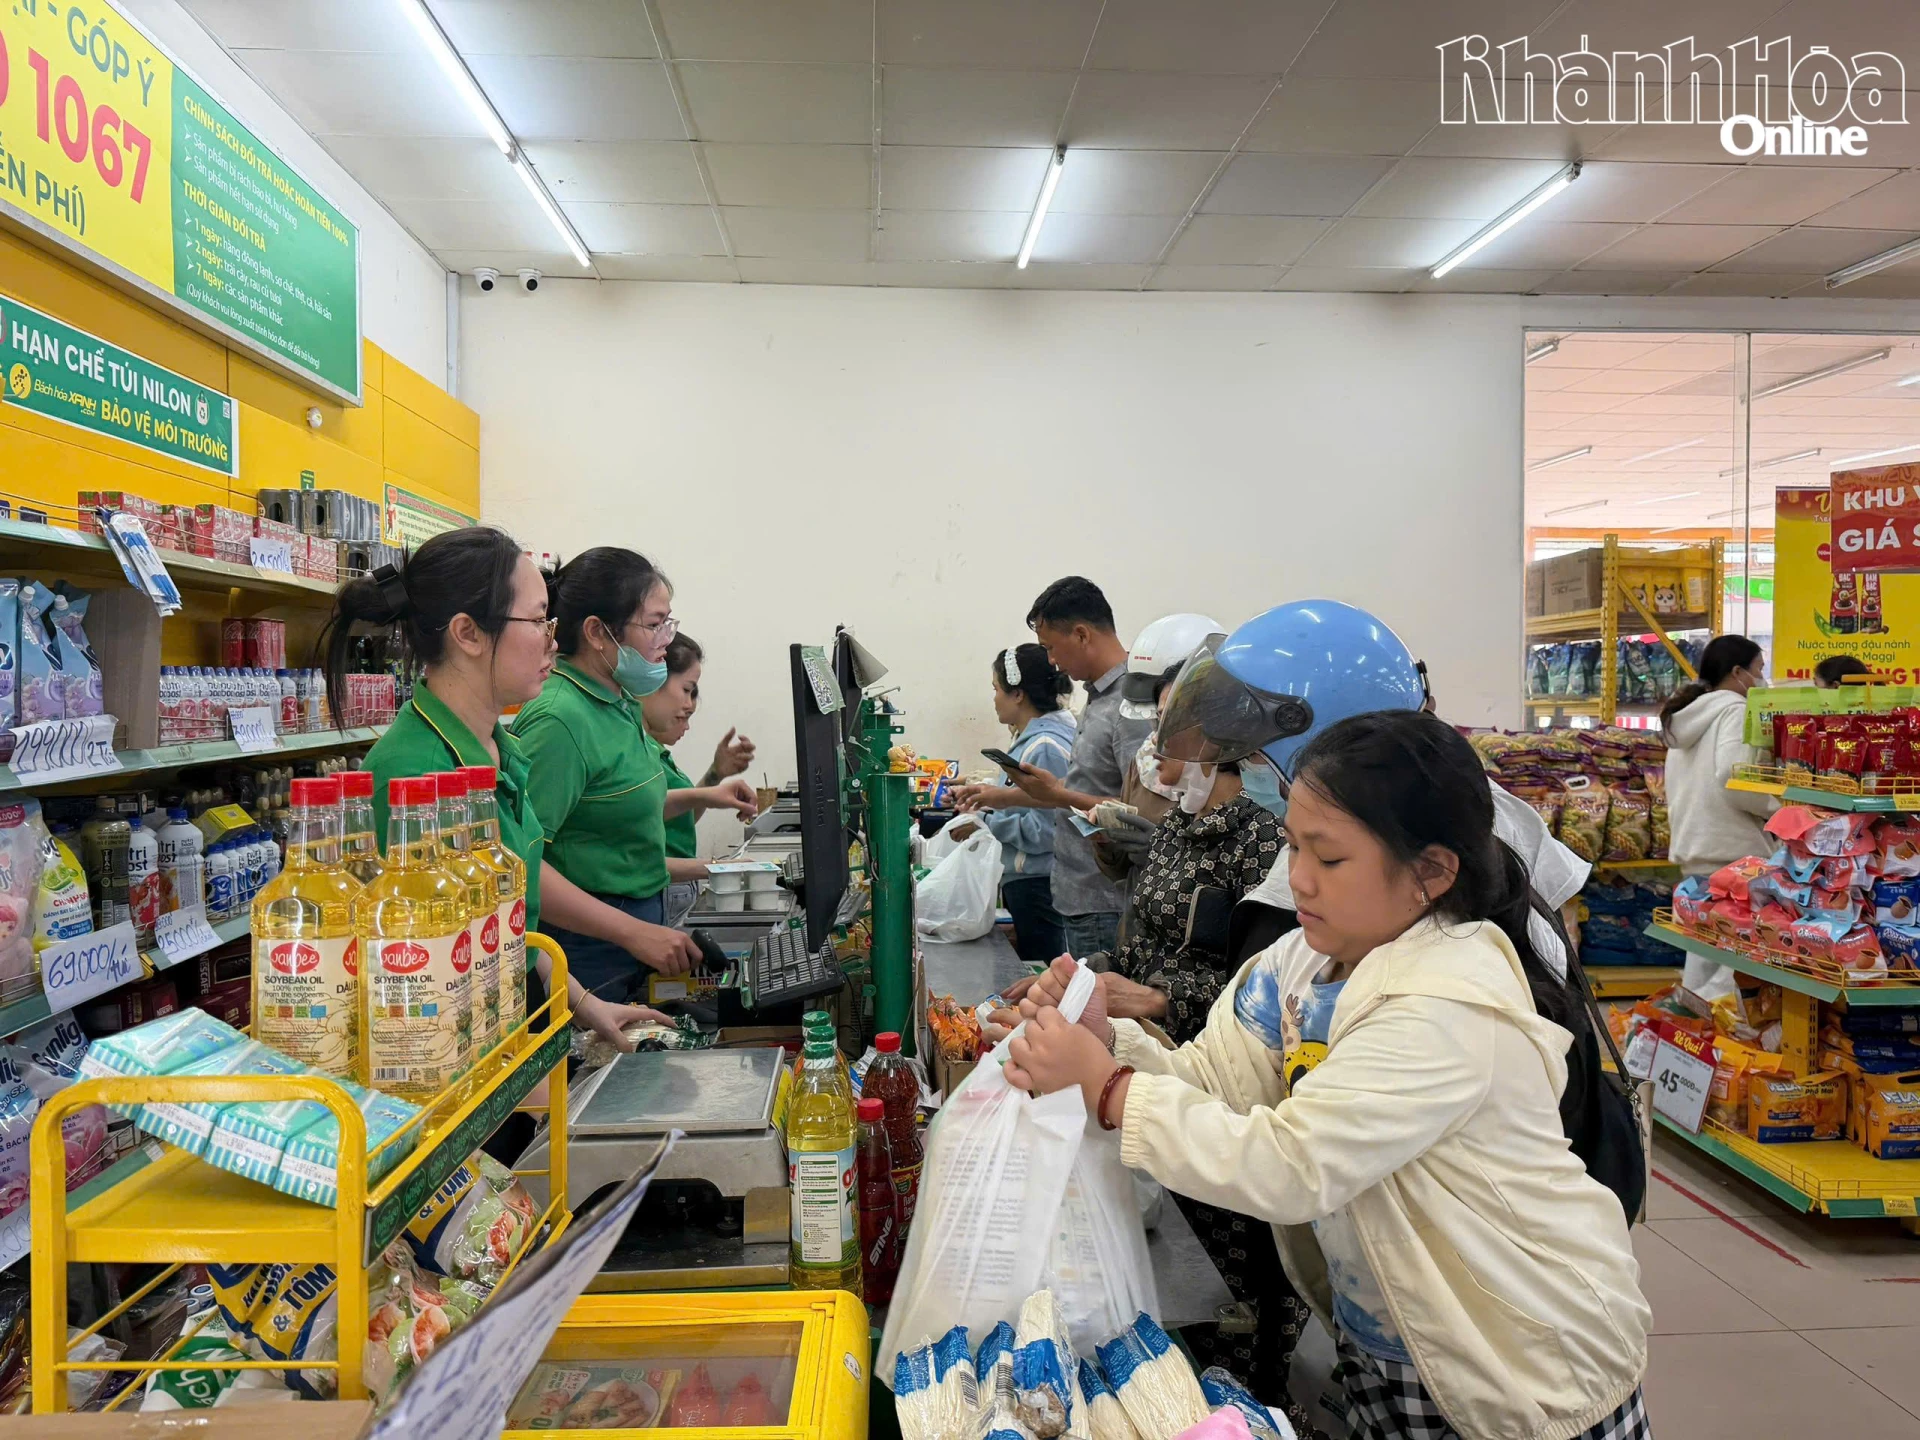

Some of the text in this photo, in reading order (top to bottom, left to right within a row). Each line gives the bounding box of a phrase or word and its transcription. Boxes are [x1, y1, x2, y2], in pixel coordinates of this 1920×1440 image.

[67, 6, 130, 84] GÓP
[137, 57, 154, 107] Ý
[28, 46, 151, 204] 1067
[184, 95, 348, 247] CHÍNH SÁCH ĐỔI TRẢ HOẶC HOÀN TIỀN 100%
[35, 170, 85, 236] PHÍ)
[183, 179, 266, 253] THỜI GIAN ĐỔI TRẢ
[195, 217, 199, 231] 1
[201, 224, 223, 248] ngày:
[223, 236, 240, 262] hàng
[195, 240, 201, 254] 2
[202, 246, 223, 270] ngày:
[224, 259, 236, 277] trái
[196, 262, 201, 275] 7
[203, 268, 224, 292] ngày:
[225, 282, 237, 298] các
[238, 289, 249, 305] sản
[12, 320, 191, 417] HẠN CHẾ TÚI NILON
[34, 379, 228, 462] Bách hóa XANH BẢO VỆ MÔI TRƯỜNG
[1843, 486, 1905, 512] KHU
[1838, 518, 1901, 553] GIÁ
[1797, 640, 1911, 651] Nước tương đậu nành
[1862, 651, 1896, 662] Maggi
[264, 976, 325, 984] SOYBEAN OIL
[291, 997, 313, 1006] quality
[374, 975, 435, 984] SOYBEAN OIL
[1684, 1036, 1705, 1056] Quá!
[869, 1215, 893, 1266] STING
[273, 1263, 338, 1332] & TÔM
